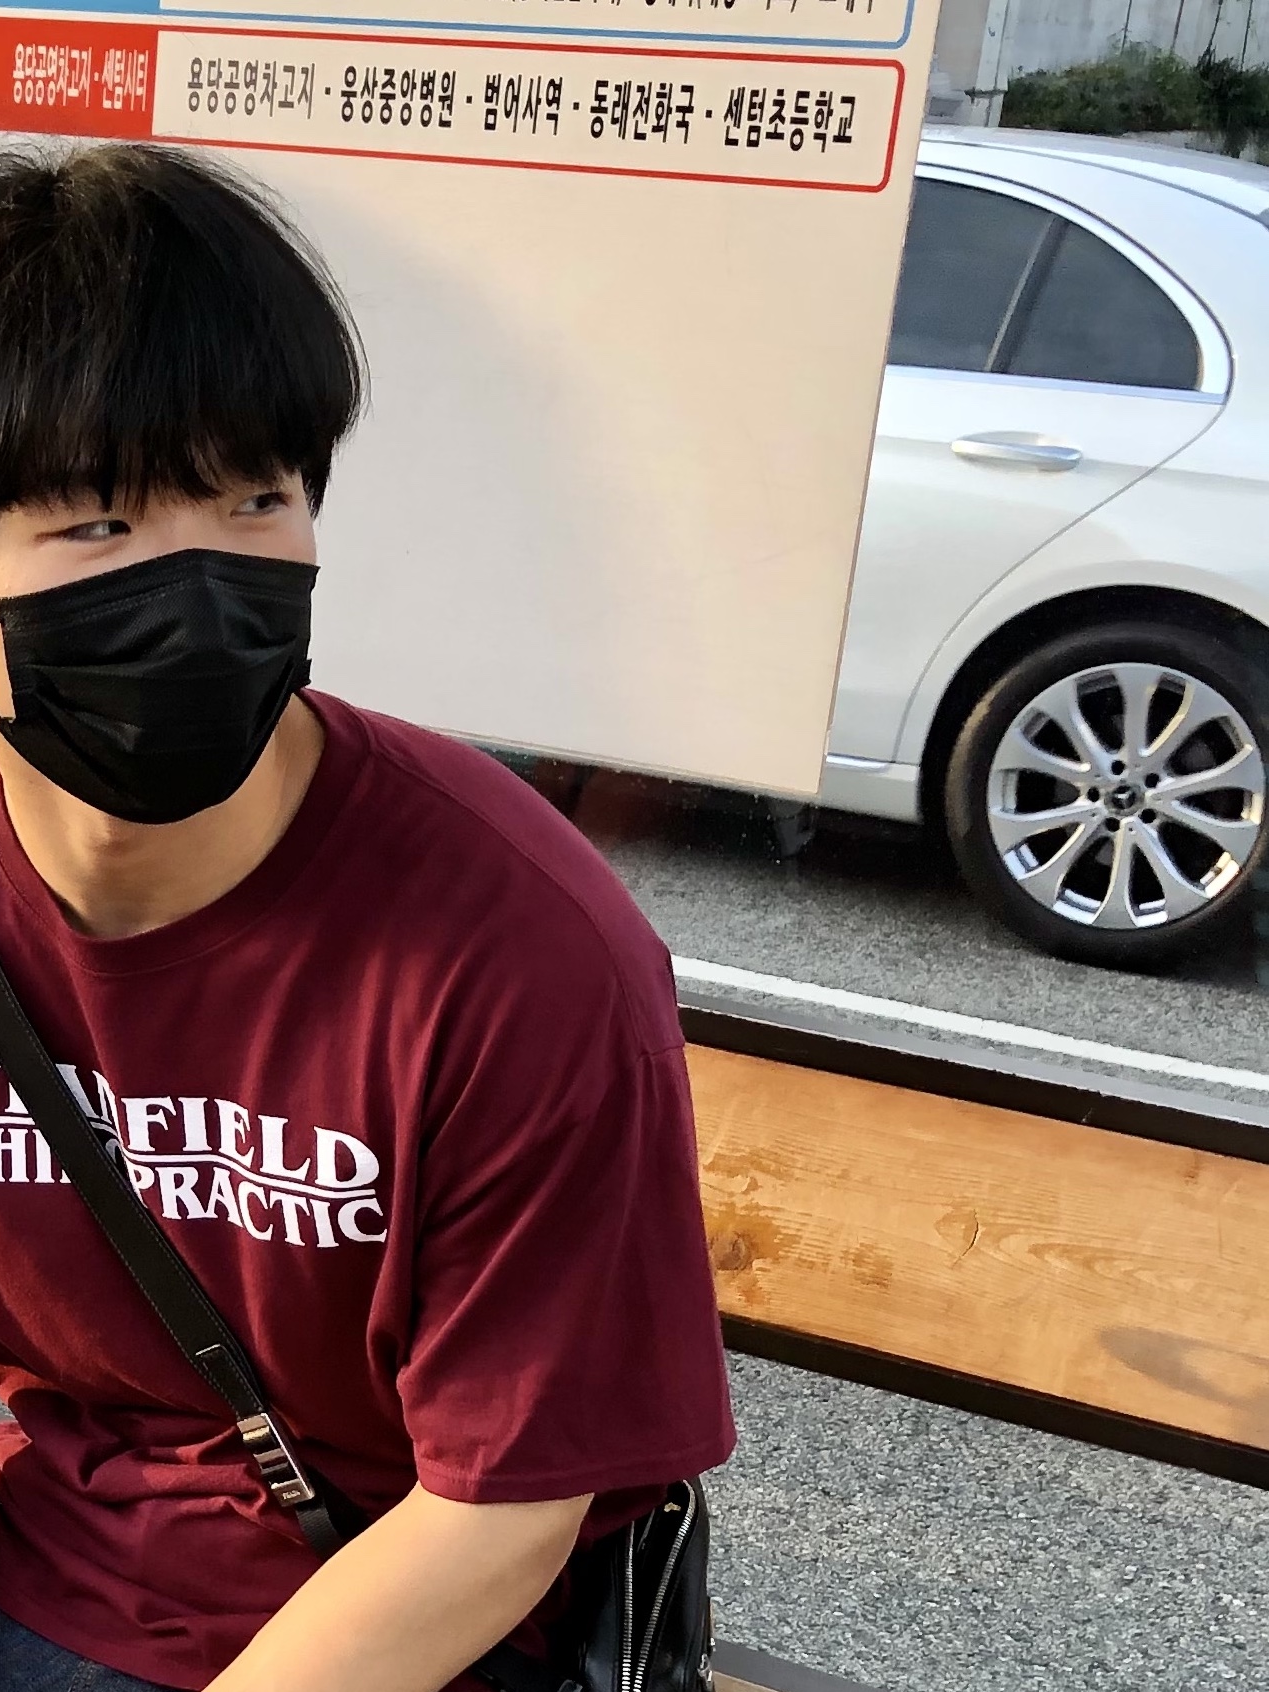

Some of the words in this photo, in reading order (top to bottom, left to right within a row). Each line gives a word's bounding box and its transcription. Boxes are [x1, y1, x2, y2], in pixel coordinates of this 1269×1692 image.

[101, 48, 149, 112] 센텀시티
[187, 57, 315, 120] 용당공영차고지
[340, 65, 457, 128] 웅상중앙병원
[484, 73, 563, 136] 범어사역
[589, 79, 695, 144] 동래전화국
[723, 86, 856, 153] 센텀초등학교
